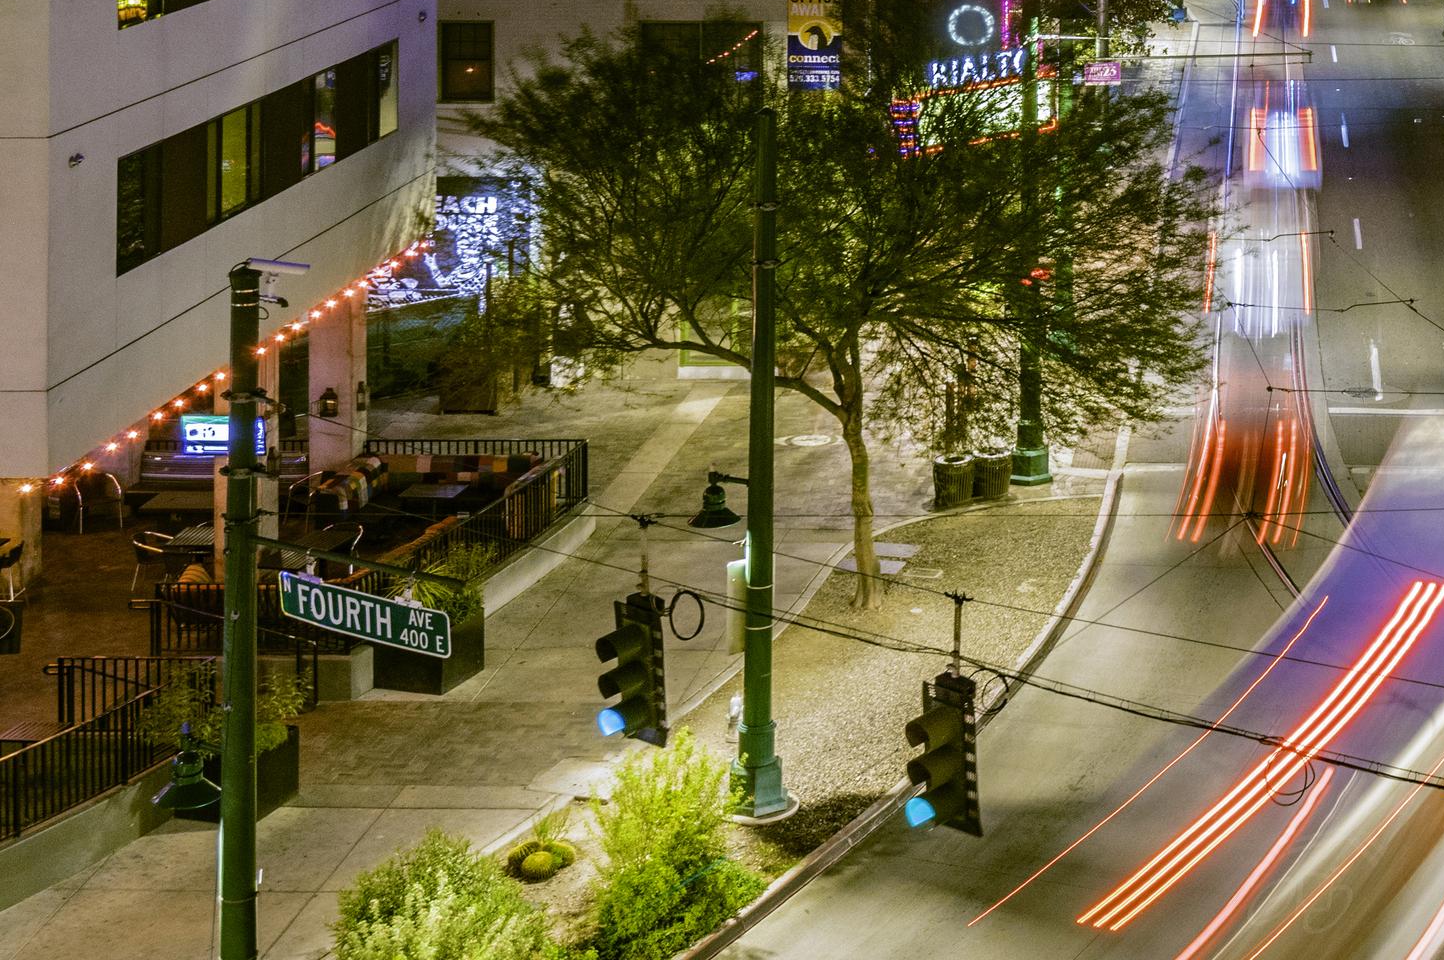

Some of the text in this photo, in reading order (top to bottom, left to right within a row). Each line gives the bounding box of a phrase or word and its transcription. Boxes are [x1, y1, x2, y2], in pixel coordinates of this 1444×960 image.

[789, 54, 840, 63] connect
[283, 578, 291, 593] N
[297, 583, 392, 638] FOURTH
[408, 610, 434, 630] AVE
[399, 628, 445, 652] 400 E
